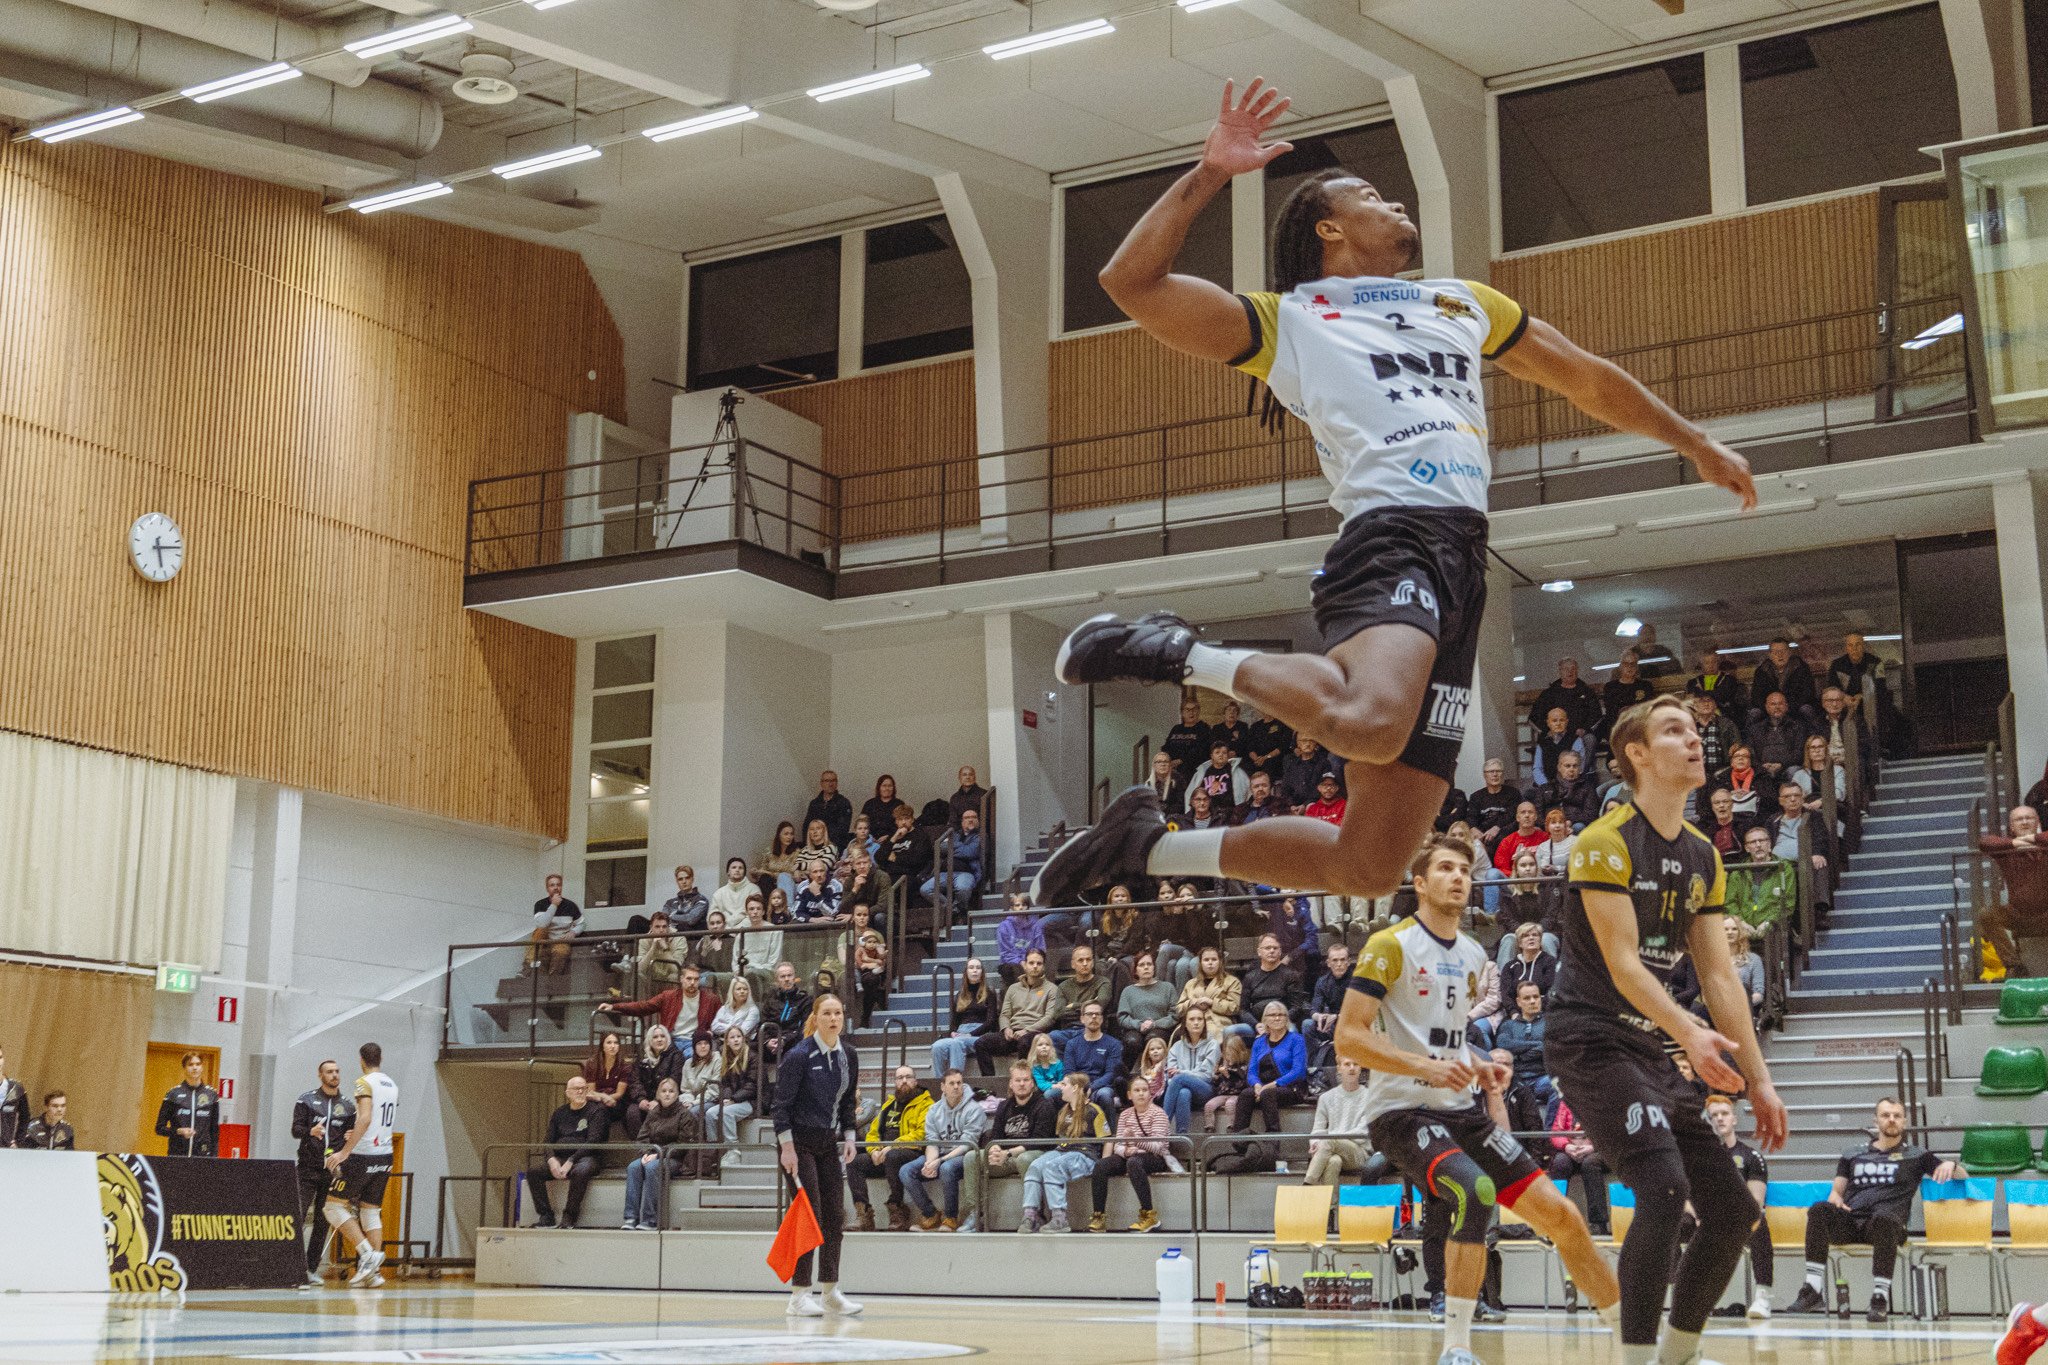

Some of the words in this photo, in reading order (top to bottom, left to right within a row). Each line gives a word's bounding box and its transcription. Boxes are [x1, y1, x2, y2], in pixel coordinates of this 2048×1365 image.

[1353, 289, 1420, 305] JOENSUU
[1385, 312, 1416, 331] 2
[1446, 985, 1456, 1010] 5
[381, 1102, 394, 1127] 10
[1854, 1162, 1898, 1177] BOLT
[171, 1214, 295, 1241] #TUNNEHURMOS
